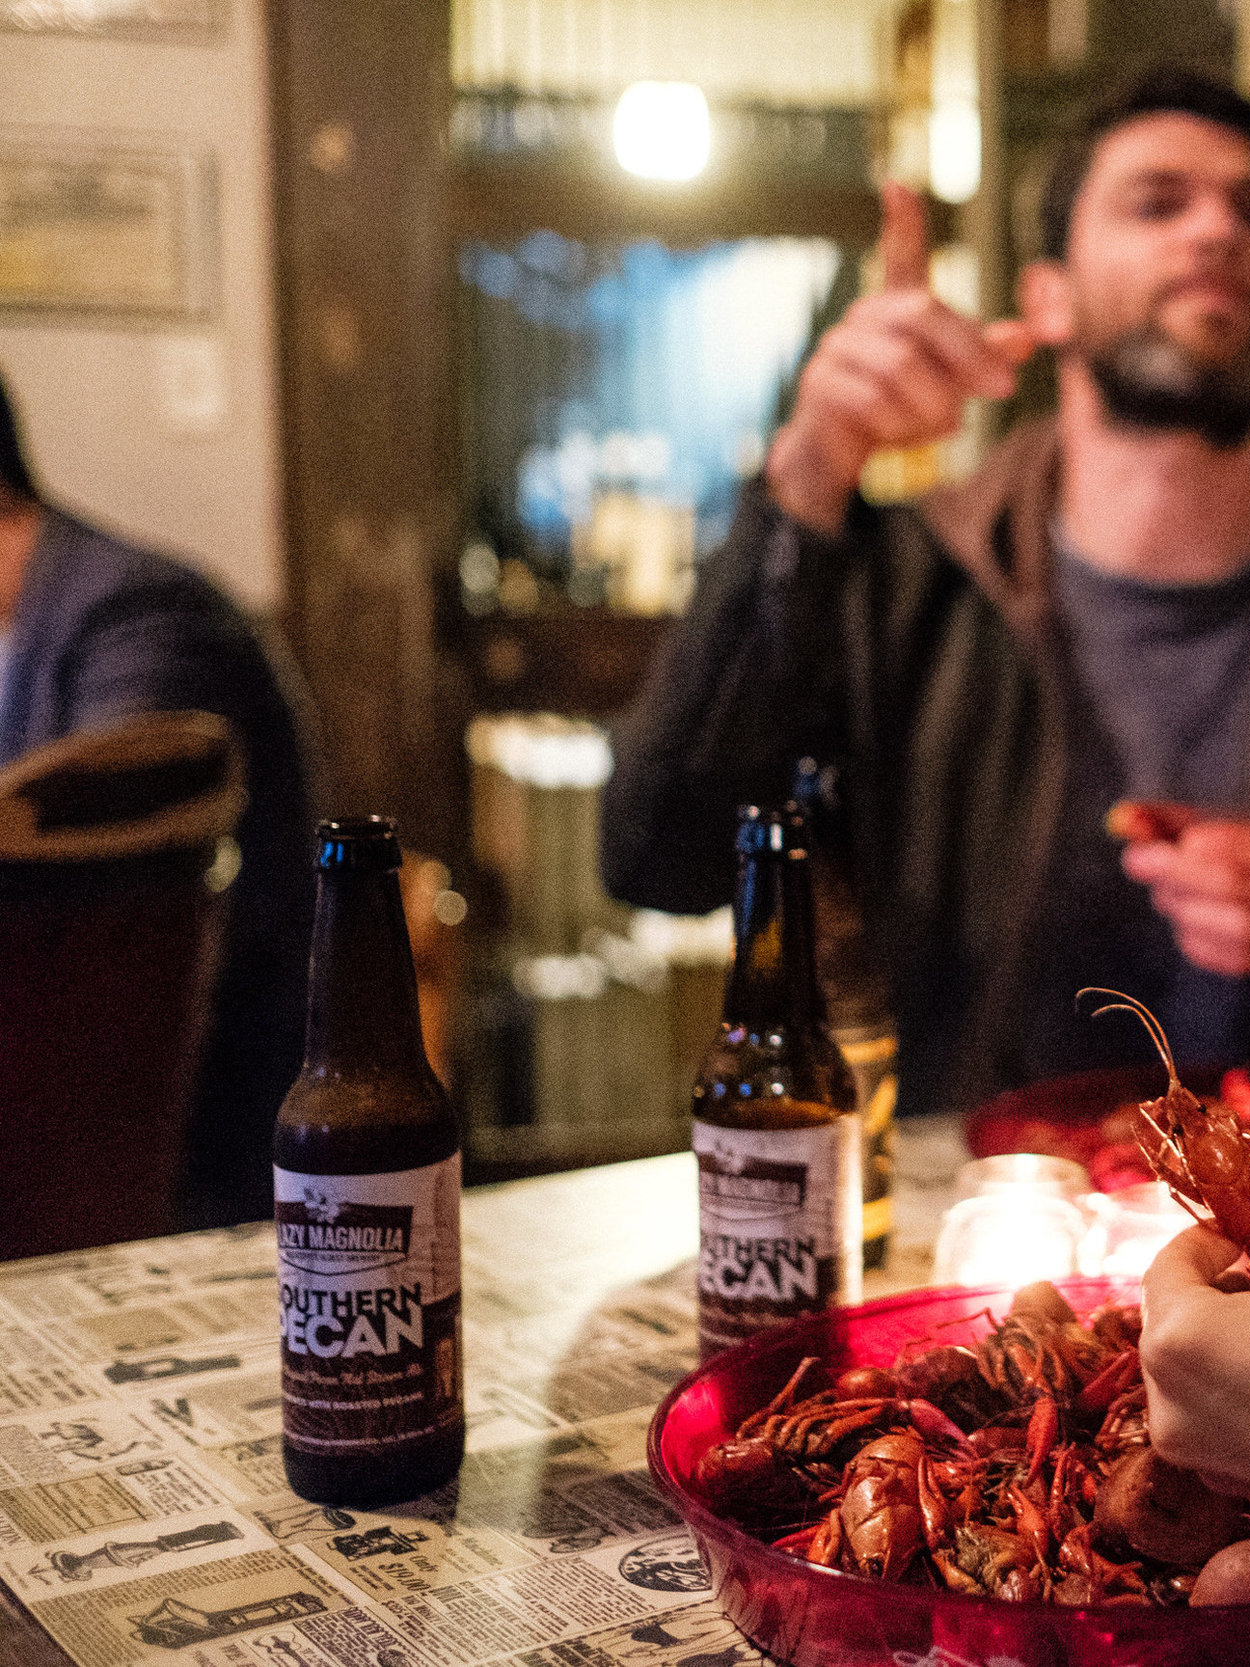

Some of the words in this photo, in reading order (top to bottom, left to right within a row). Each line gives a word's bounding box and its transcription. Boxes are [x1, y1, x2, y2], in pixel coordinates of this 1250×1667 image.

[279, 1223, 305, 1248] AZY
[308, 1224, 404, 1250] MAGNOLIA
[699, 1251, 818, 1302] ECAN
[281, 1282, 421, 1317] OUTHERN
[378, 1563, 431, 1591] $19.00
